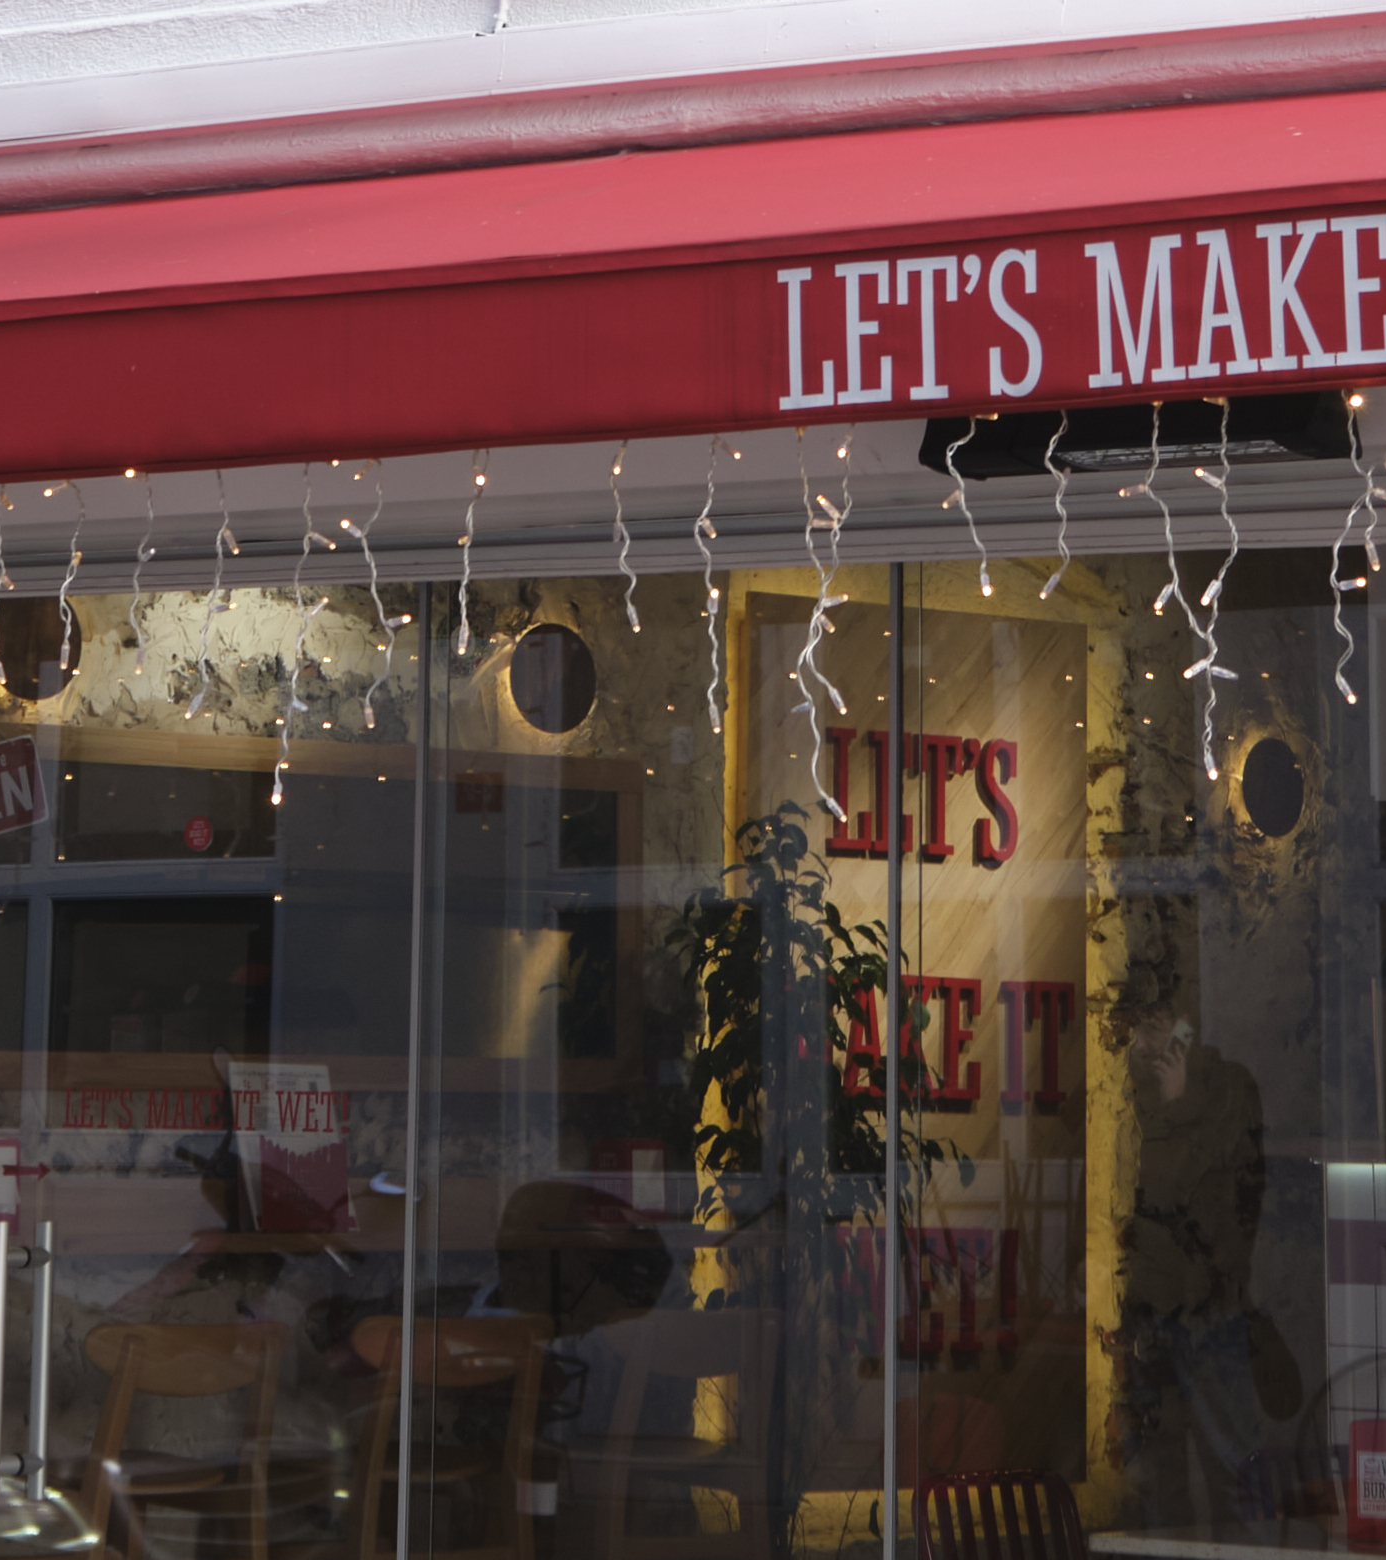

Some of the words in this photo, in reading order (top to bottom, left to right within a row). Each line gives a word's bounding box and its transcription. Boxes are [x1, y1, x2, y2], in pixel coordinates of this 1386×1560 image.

[777, 249, 1043, 410] LET'S
[824, 727, 1019, 862] LET'S
[999, 981, 1076, 1102] IT
[64, 1088, 133, 1130] LET'S
[146, 1088, 224, 1130] MAKE
[233, 1090, 260, 1131] IT
[276, 1091, 349, 1134] WET!
